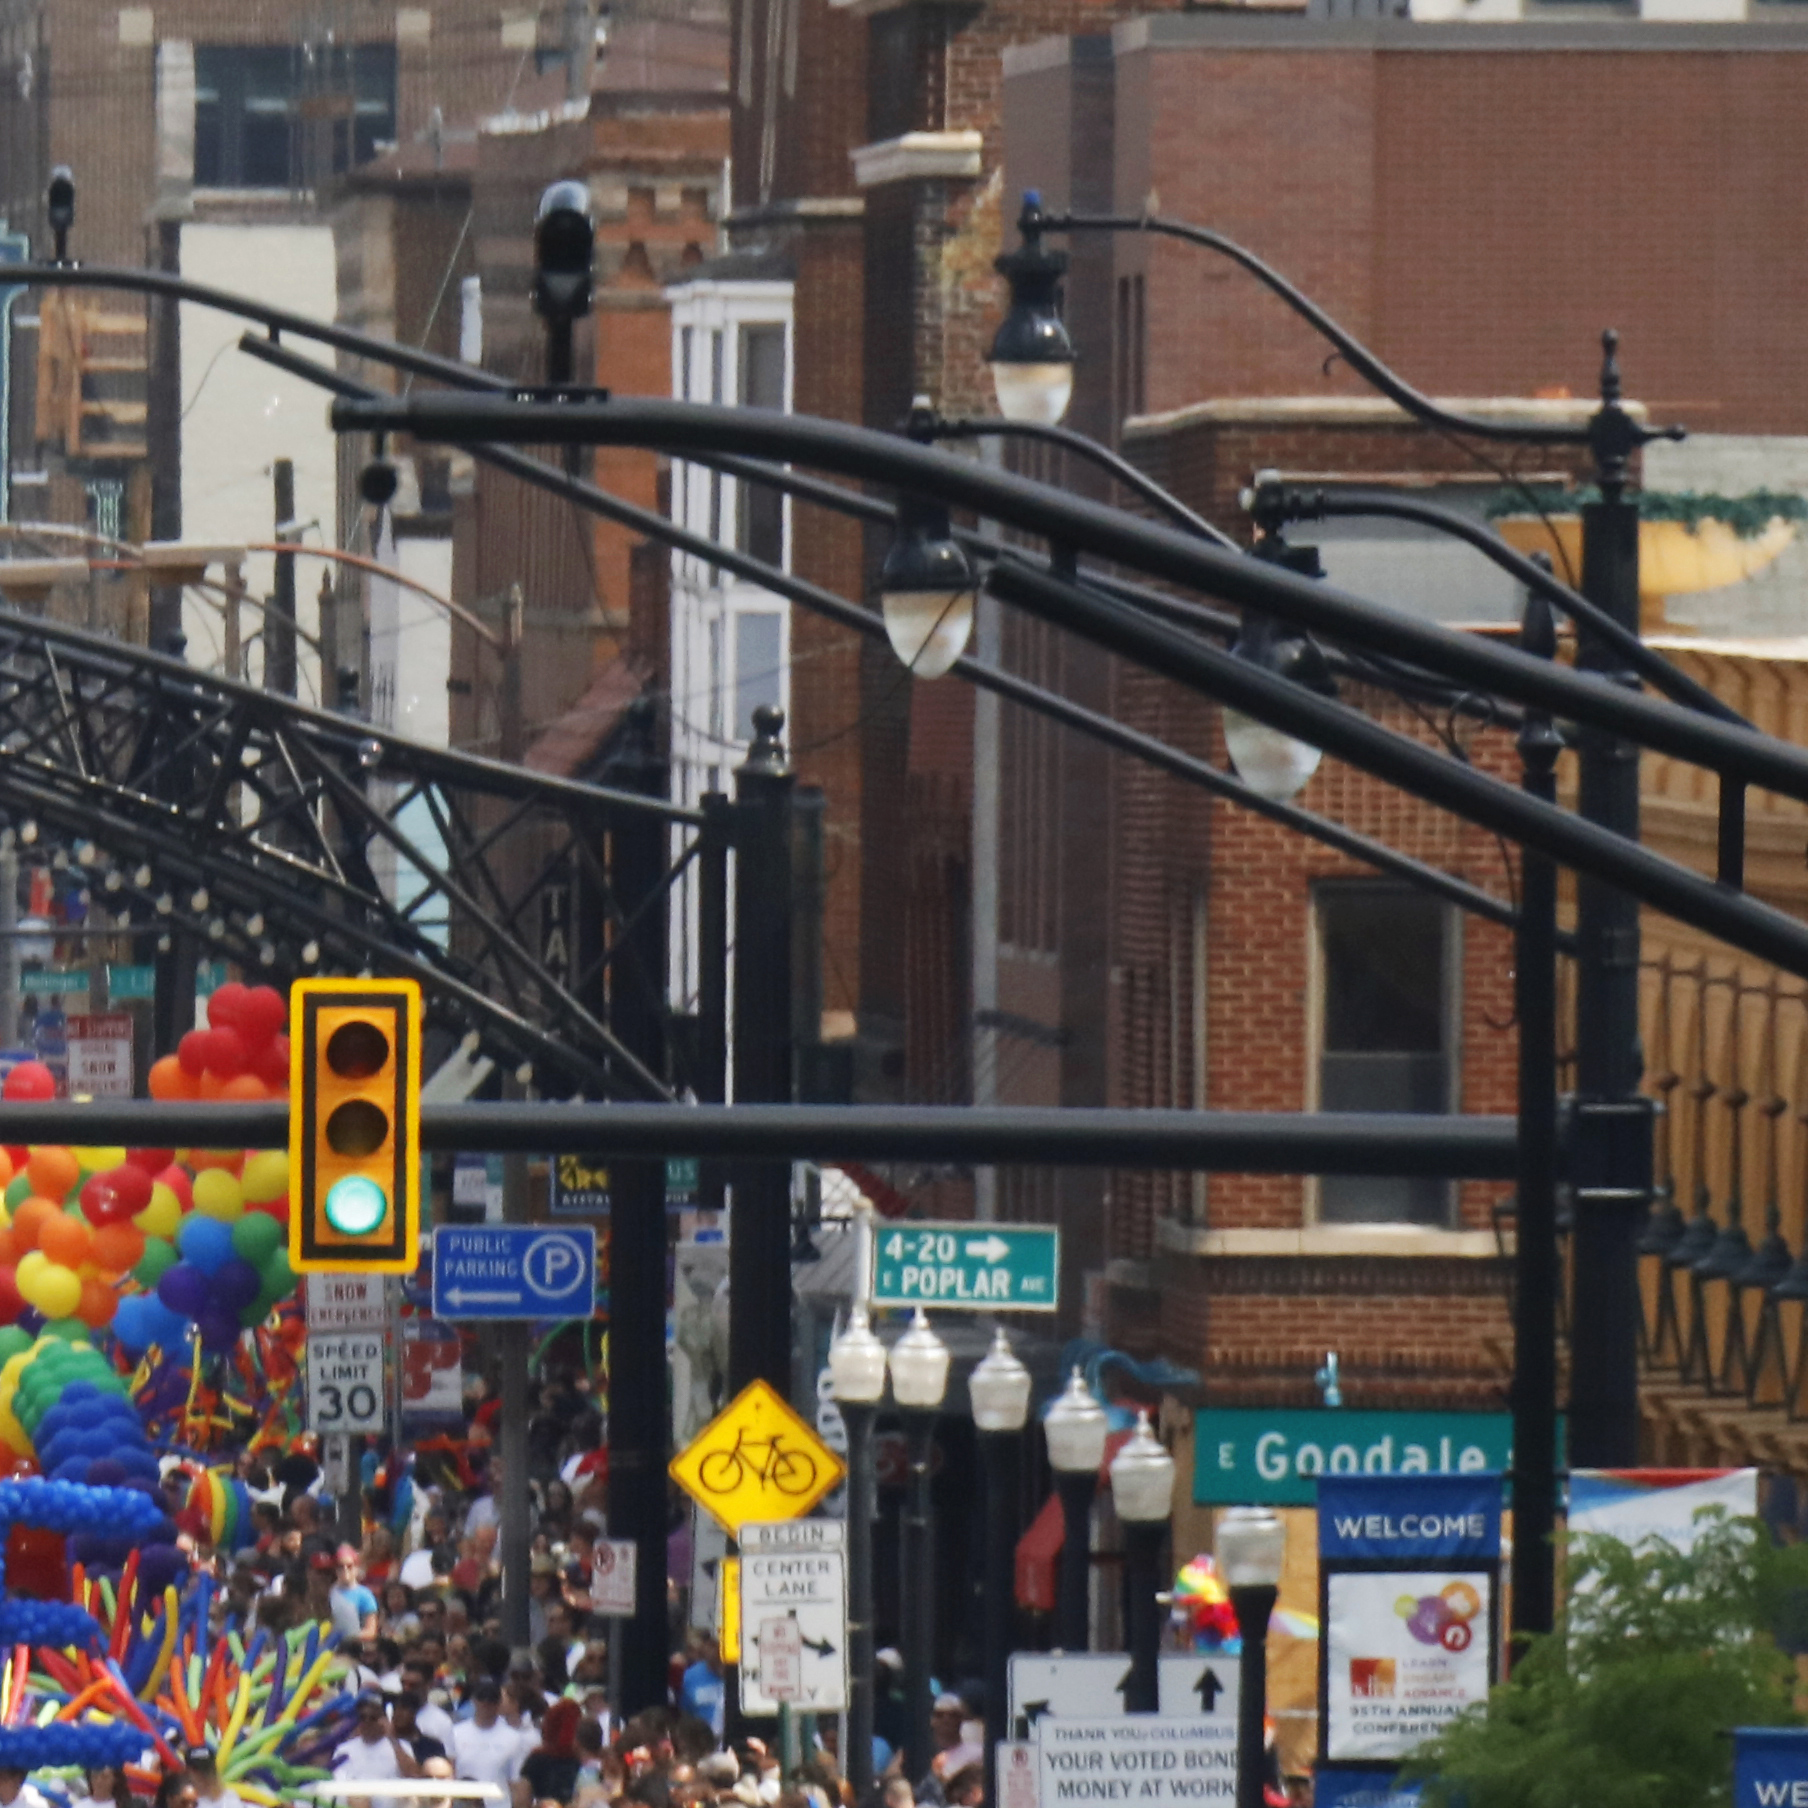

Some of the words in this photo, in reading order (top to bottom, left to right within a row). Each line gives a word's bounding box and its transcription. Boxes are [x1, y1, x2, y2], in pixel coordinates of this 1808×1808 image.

[449, 1234, 512, 1254] PUBLIC
[884, 1232, 957, 1263] 4-20
[444, 1259, 519, 1278] PARKING
[901, 1265, 1011, 1299] POPLAR
[313, 1342, 378, 1361] SPEED
[319, 1364, 369, 1381] LIMIT
[317, 1385, 377, 1422] 30
[1255, 1431, 1488, 1481] Goodale
[759, 1526, 824, 1542] BEGIN
[1334, 1515, 1485, 1539] WELCOME
[752, 1560, 830, 1576] CENTER
[765, 1582, 818, 1597] LANE
[1055, 1727, 1106, 1741] THANK
[1047, 1750, 1103, 1771] YOUR
[1111, 1750, 1176, 1771] VOTED
[1057, 1779, 1132, 1799] MONEY
[1139, 1779, 1162, 1797] AT
[1170, 1779, 1235, 1798] WORK
